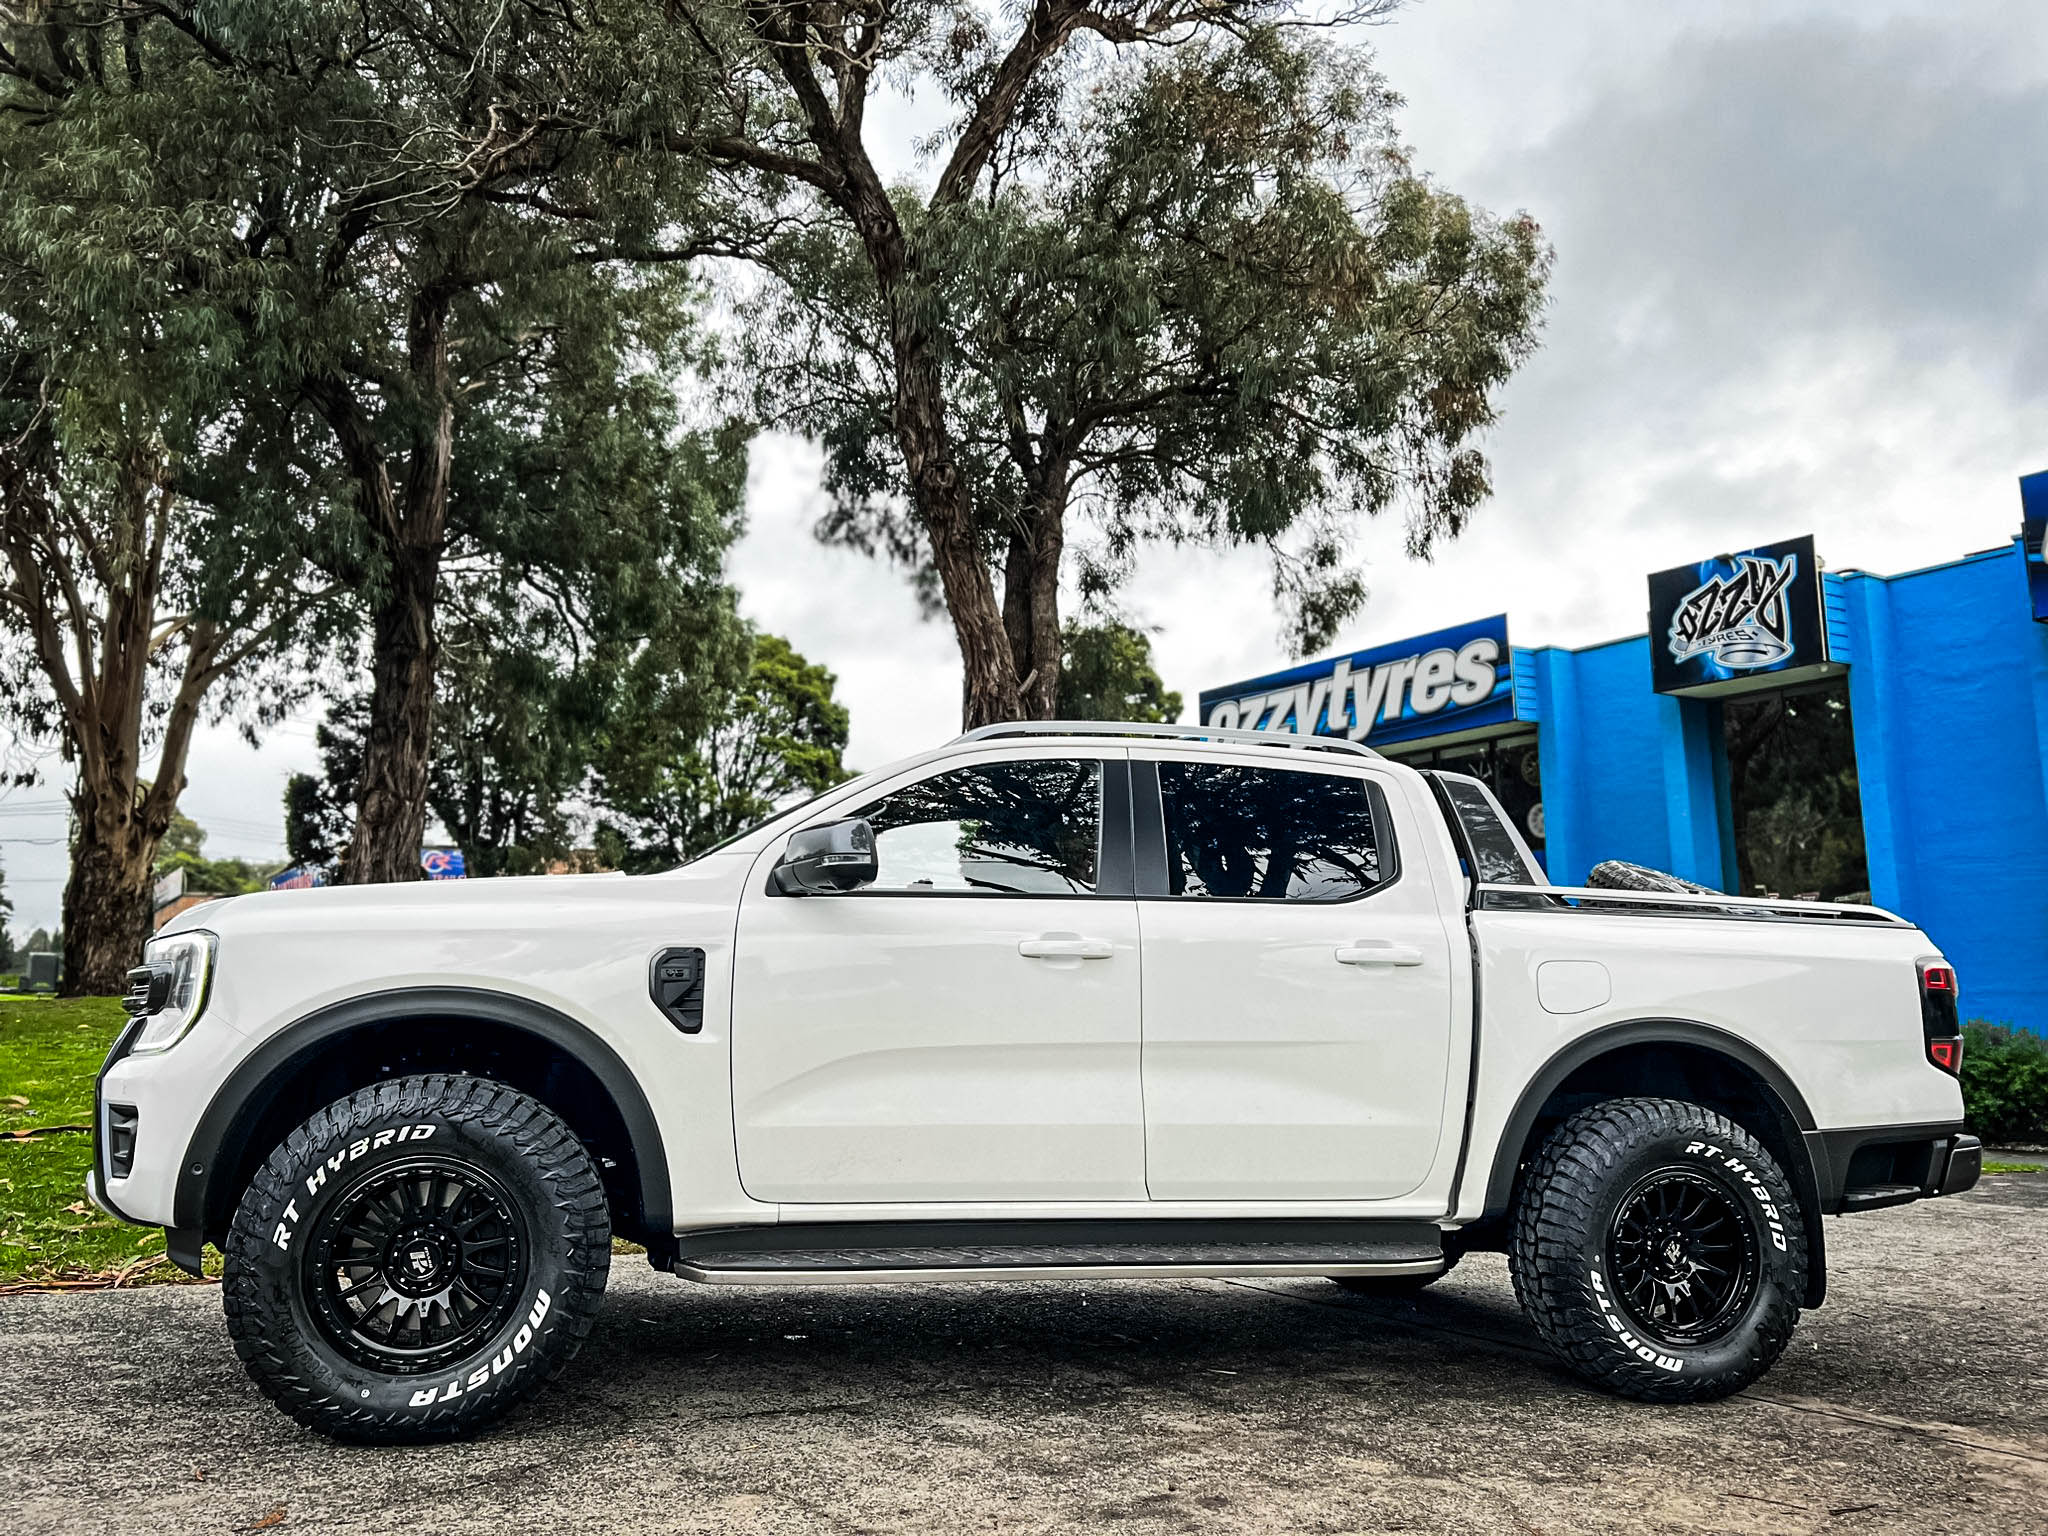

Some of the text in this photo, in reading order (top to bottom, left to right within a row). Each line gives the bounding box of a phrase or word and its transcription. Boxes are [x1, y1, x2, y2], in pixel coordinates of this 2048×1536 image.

[268, 1124, 436, 1251] RT HYBRID
[408, 1288, 551, 1407] MONSTA
[1591, 1269, 1684, 1372] MONSTA
